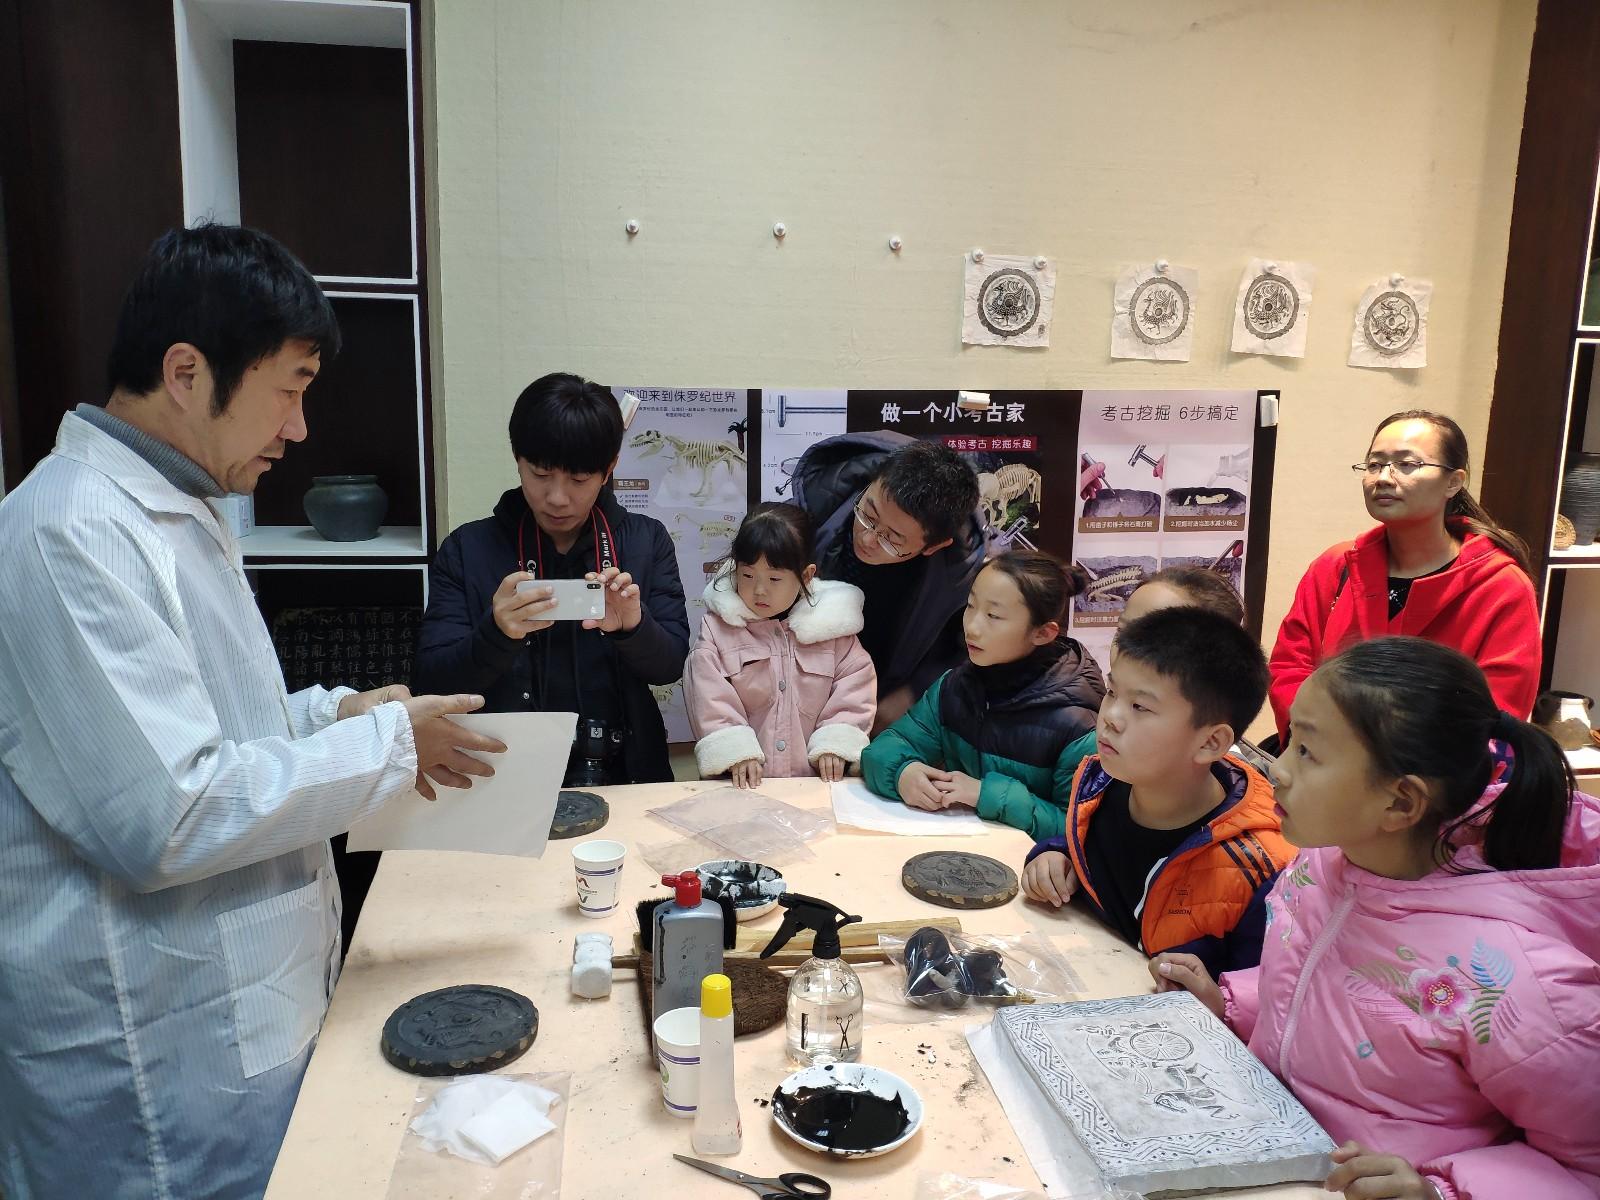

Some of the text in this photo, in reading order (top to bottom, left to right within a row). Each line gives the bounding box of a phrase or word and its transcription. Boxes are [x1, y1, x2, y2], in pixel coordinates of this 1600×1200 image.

[880, 401, 1026, 423] 做一个小考古家
[1100, 404, 1239, 422] 考古挖掘 6步搞定
[947, 438, 1032, 449] 体验考古 挖掘乐趣
[602, 539, 611, 557] Mark
